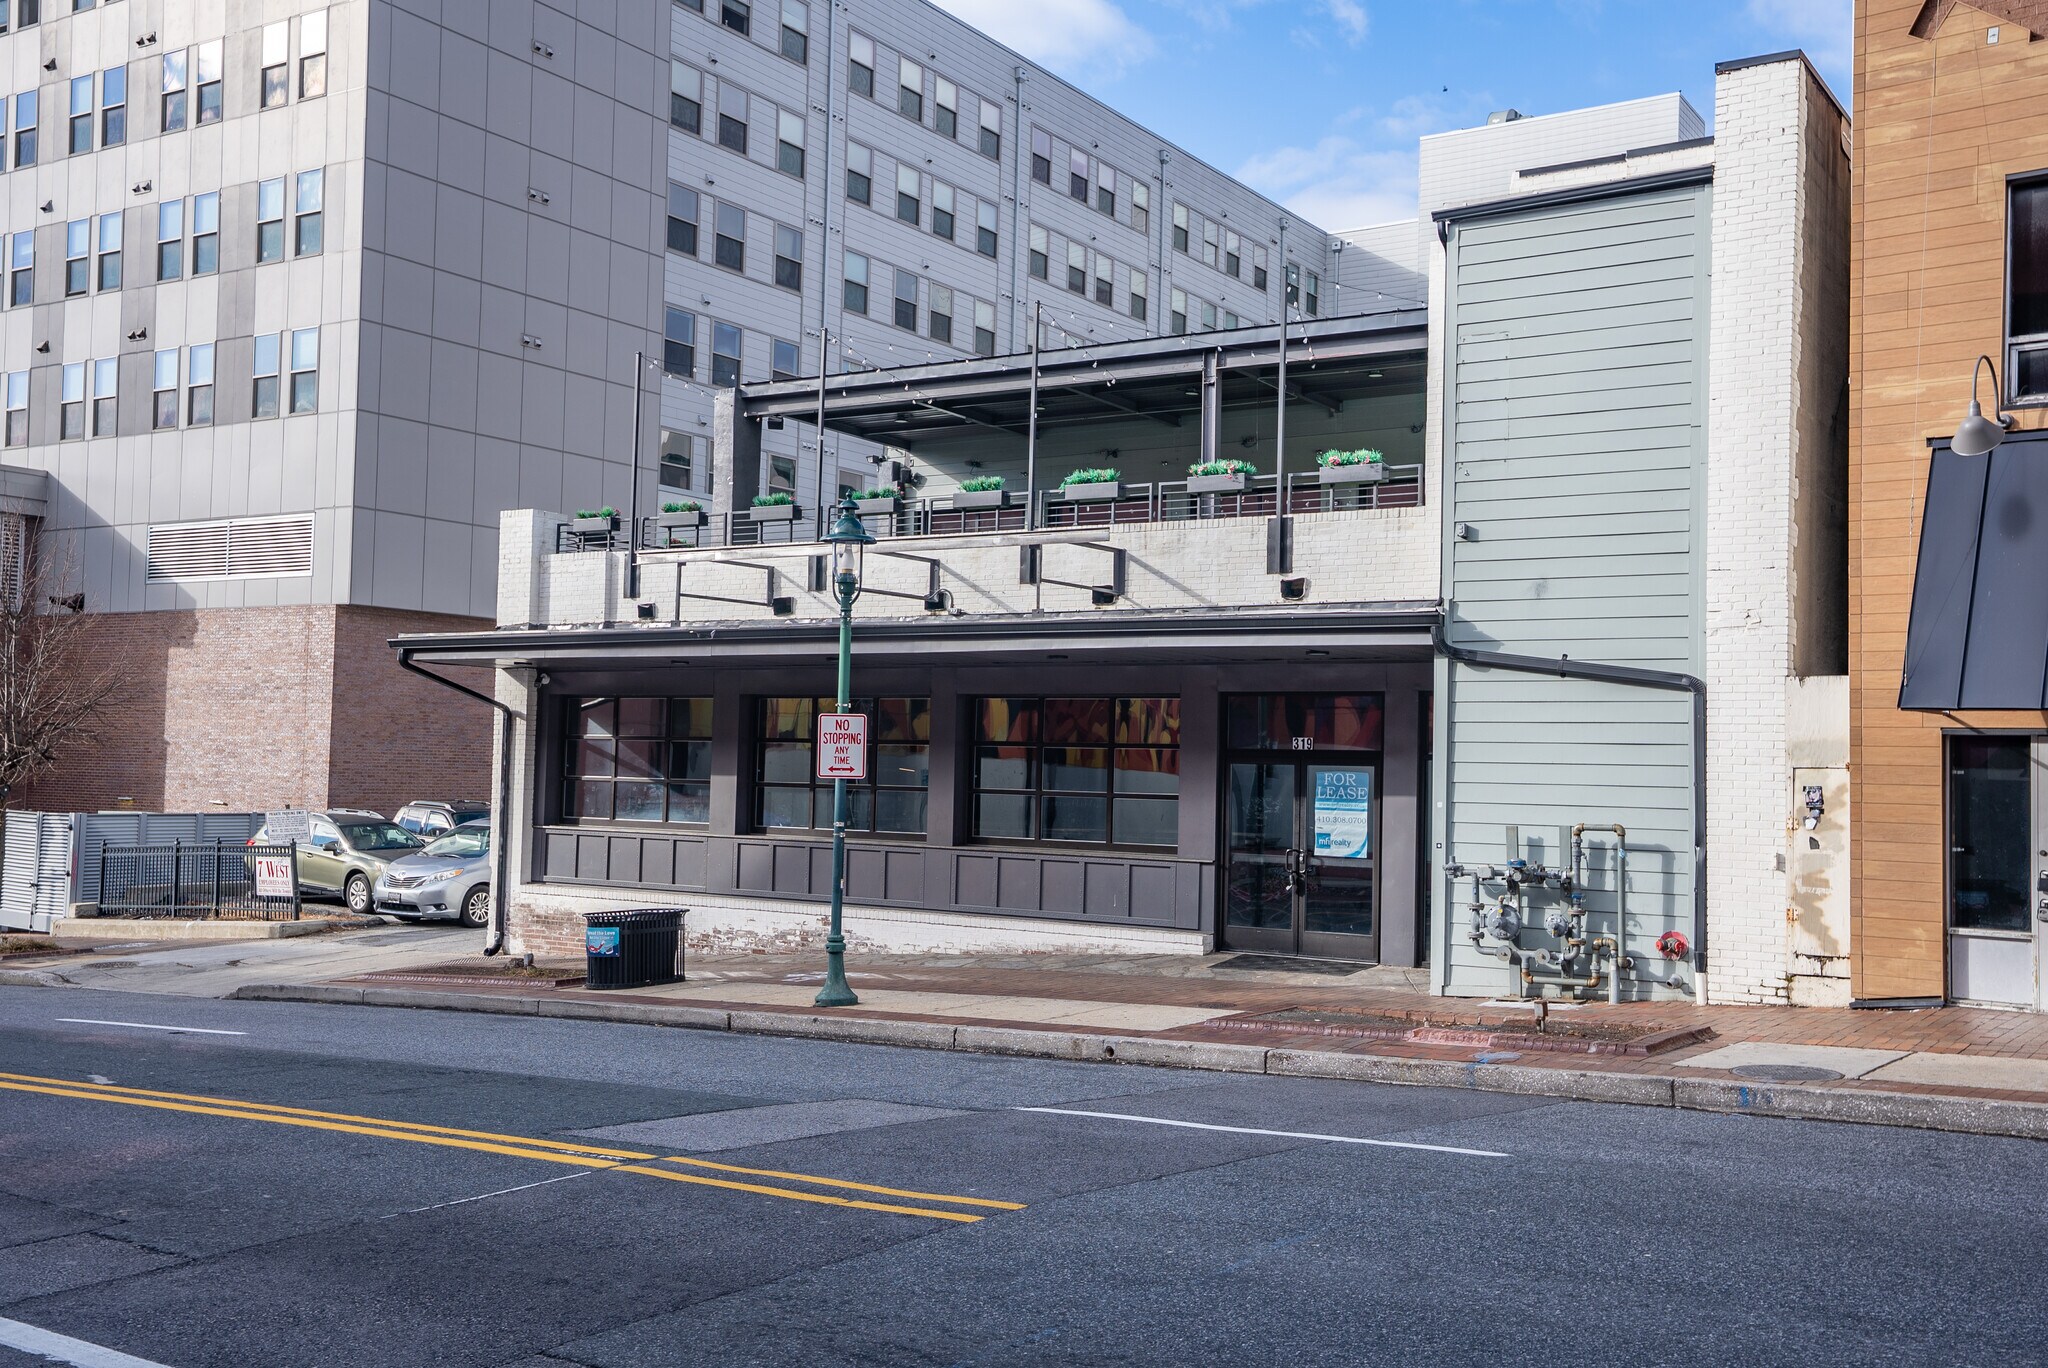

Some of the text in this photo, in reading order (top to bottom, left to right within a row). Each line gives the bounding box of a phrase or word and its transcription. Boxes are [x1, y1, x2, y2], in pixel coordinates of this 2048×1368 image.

[835, 719, 850, 731] NO
[823, 732, 862, 745] STOPPING
[1293, 738, 1312, 749] 319
[834, 746, 850, 755] ANY
[834, 756, 850, 765] TIME
[1324, 772, 1356, 786] FOR
[1317, 786, 1368, 800] LEASE
[1317, 816, 1366, 824] 410.308.0700
[1331, 839, 1351, 848] realty
[258, 861, 263, 877] 7
